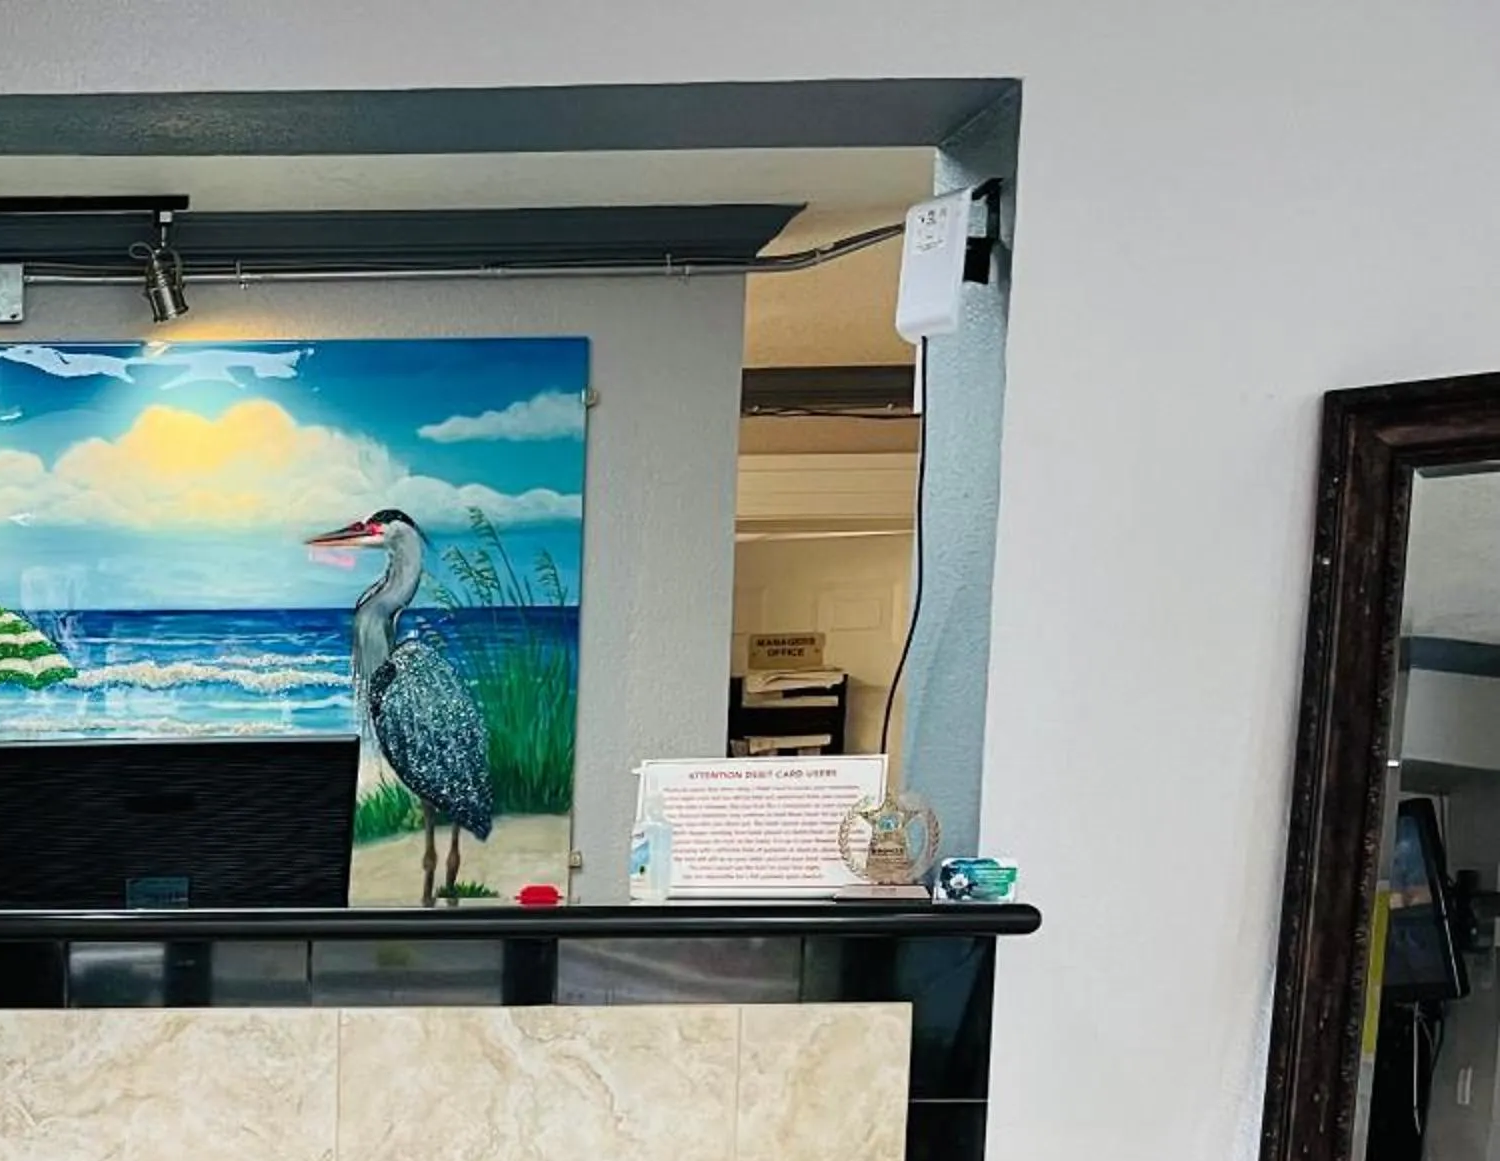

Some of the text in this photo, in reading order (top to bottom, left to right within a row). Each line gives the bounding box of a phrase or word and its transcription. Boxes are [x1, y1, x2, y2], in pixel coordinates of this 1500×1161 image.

[766, 647, 805, 657] OFFICE
[689, 770, 743, 780] ATTENTION
[775, 768, 803, 779] CARD
[805, 768, 837, 778] USERS
